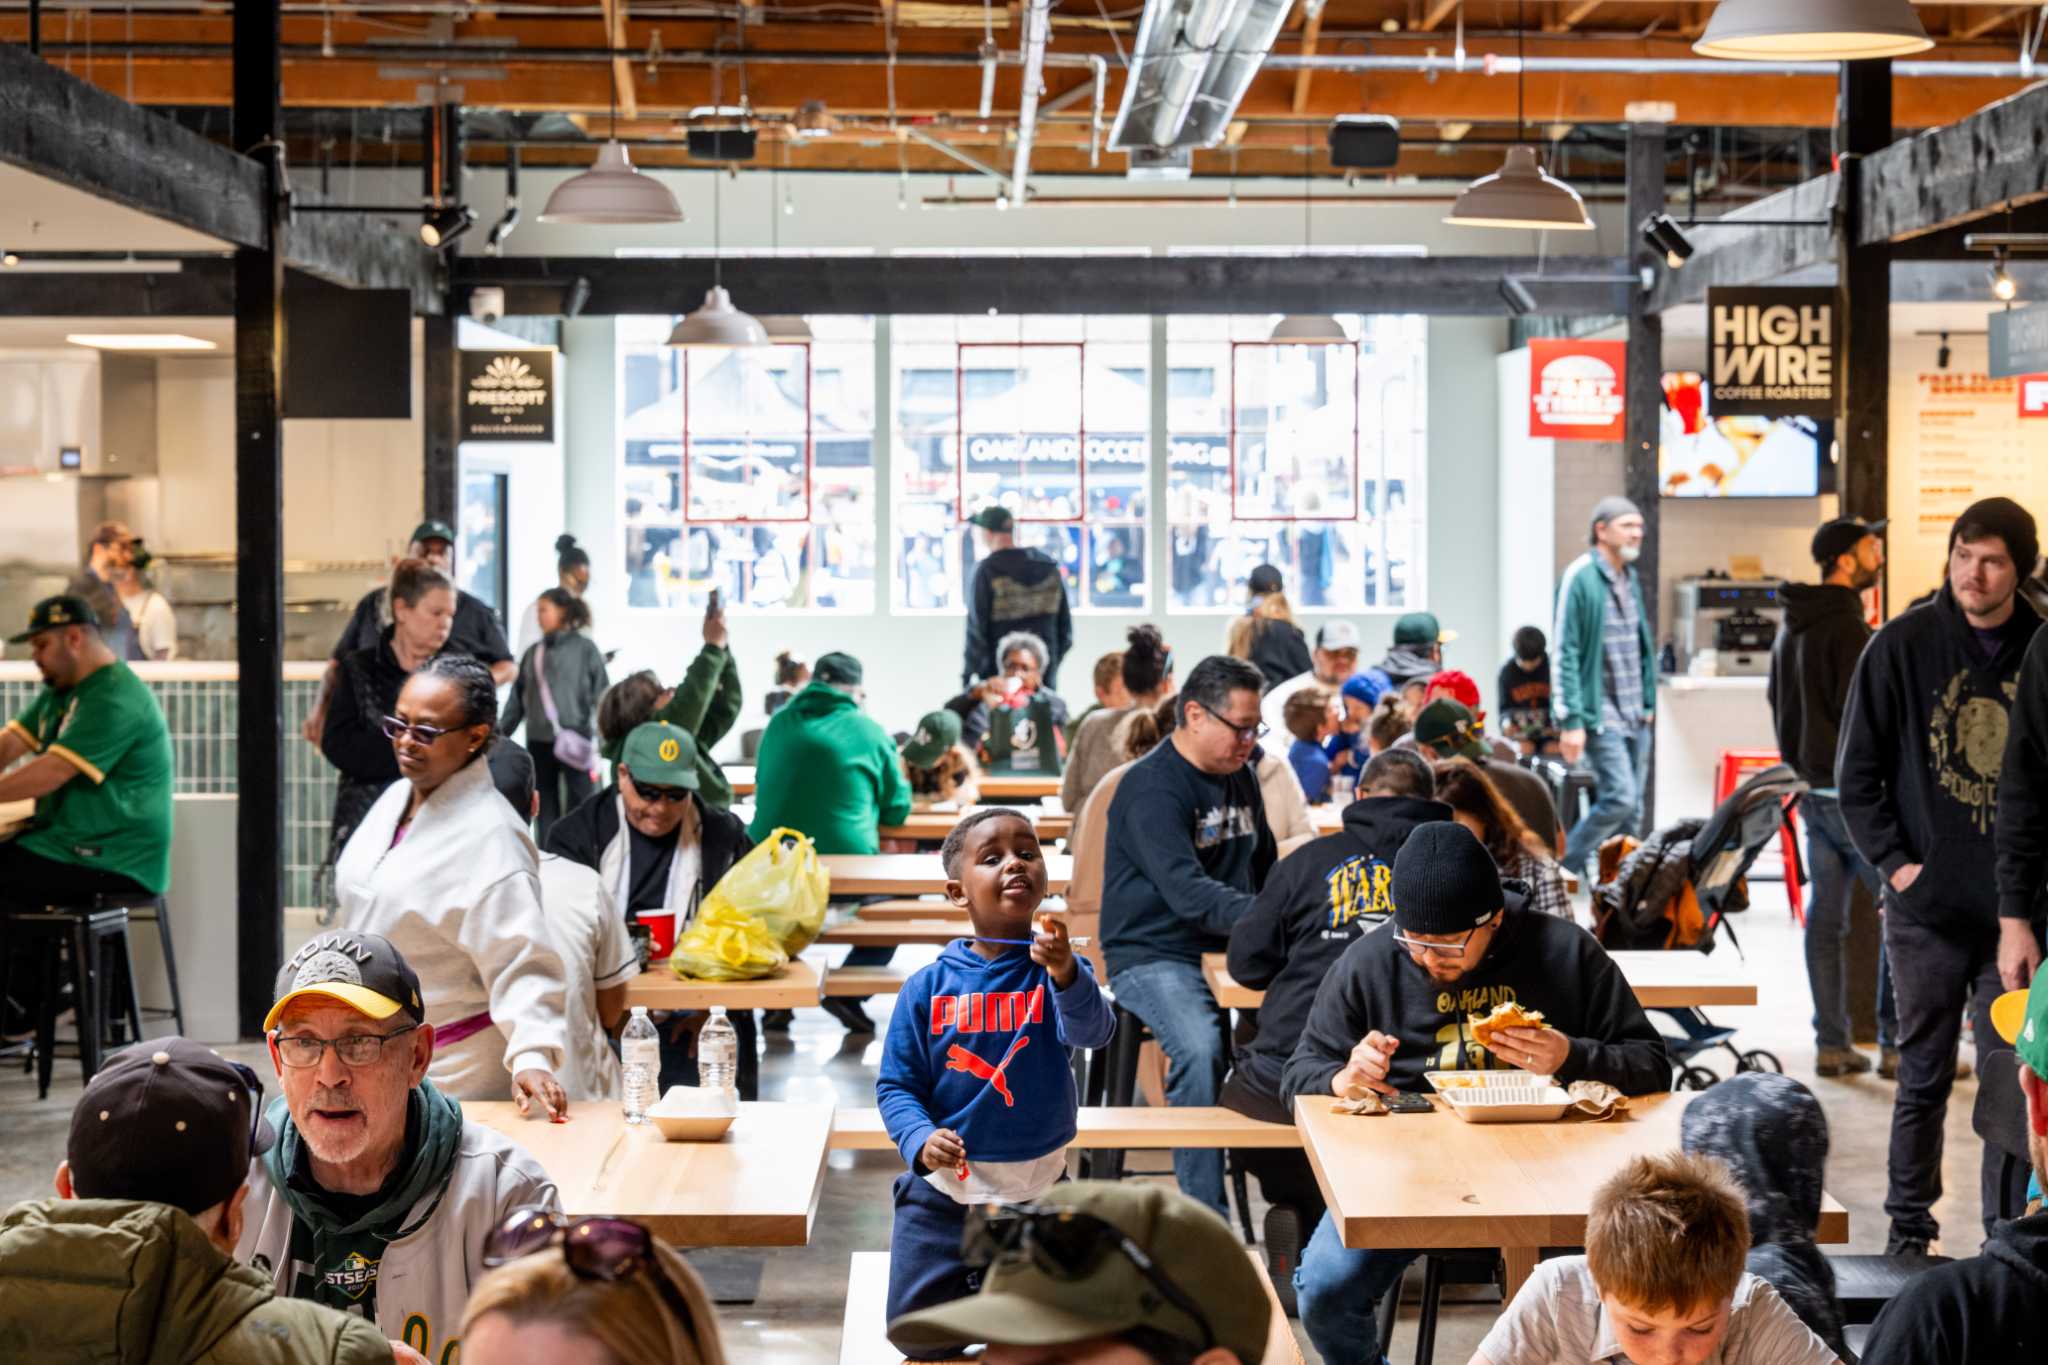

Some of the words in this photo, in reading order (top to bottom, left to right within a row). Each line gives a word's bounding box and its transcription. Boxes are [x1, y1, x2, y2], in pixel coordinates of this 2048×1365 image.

[1714, 304, 1832, 345] HIGH
[1714, 345, 1832, 385] WIRE
[1714, 386, 1763, 400] COFFEE
[1764, 386, 1832, 400] ROASTERS
[287, 935, 373, 973] TOWN
[931, 984, 1045, 1035] PUMA
[324, 1268, 377, 1285] STSEAS
